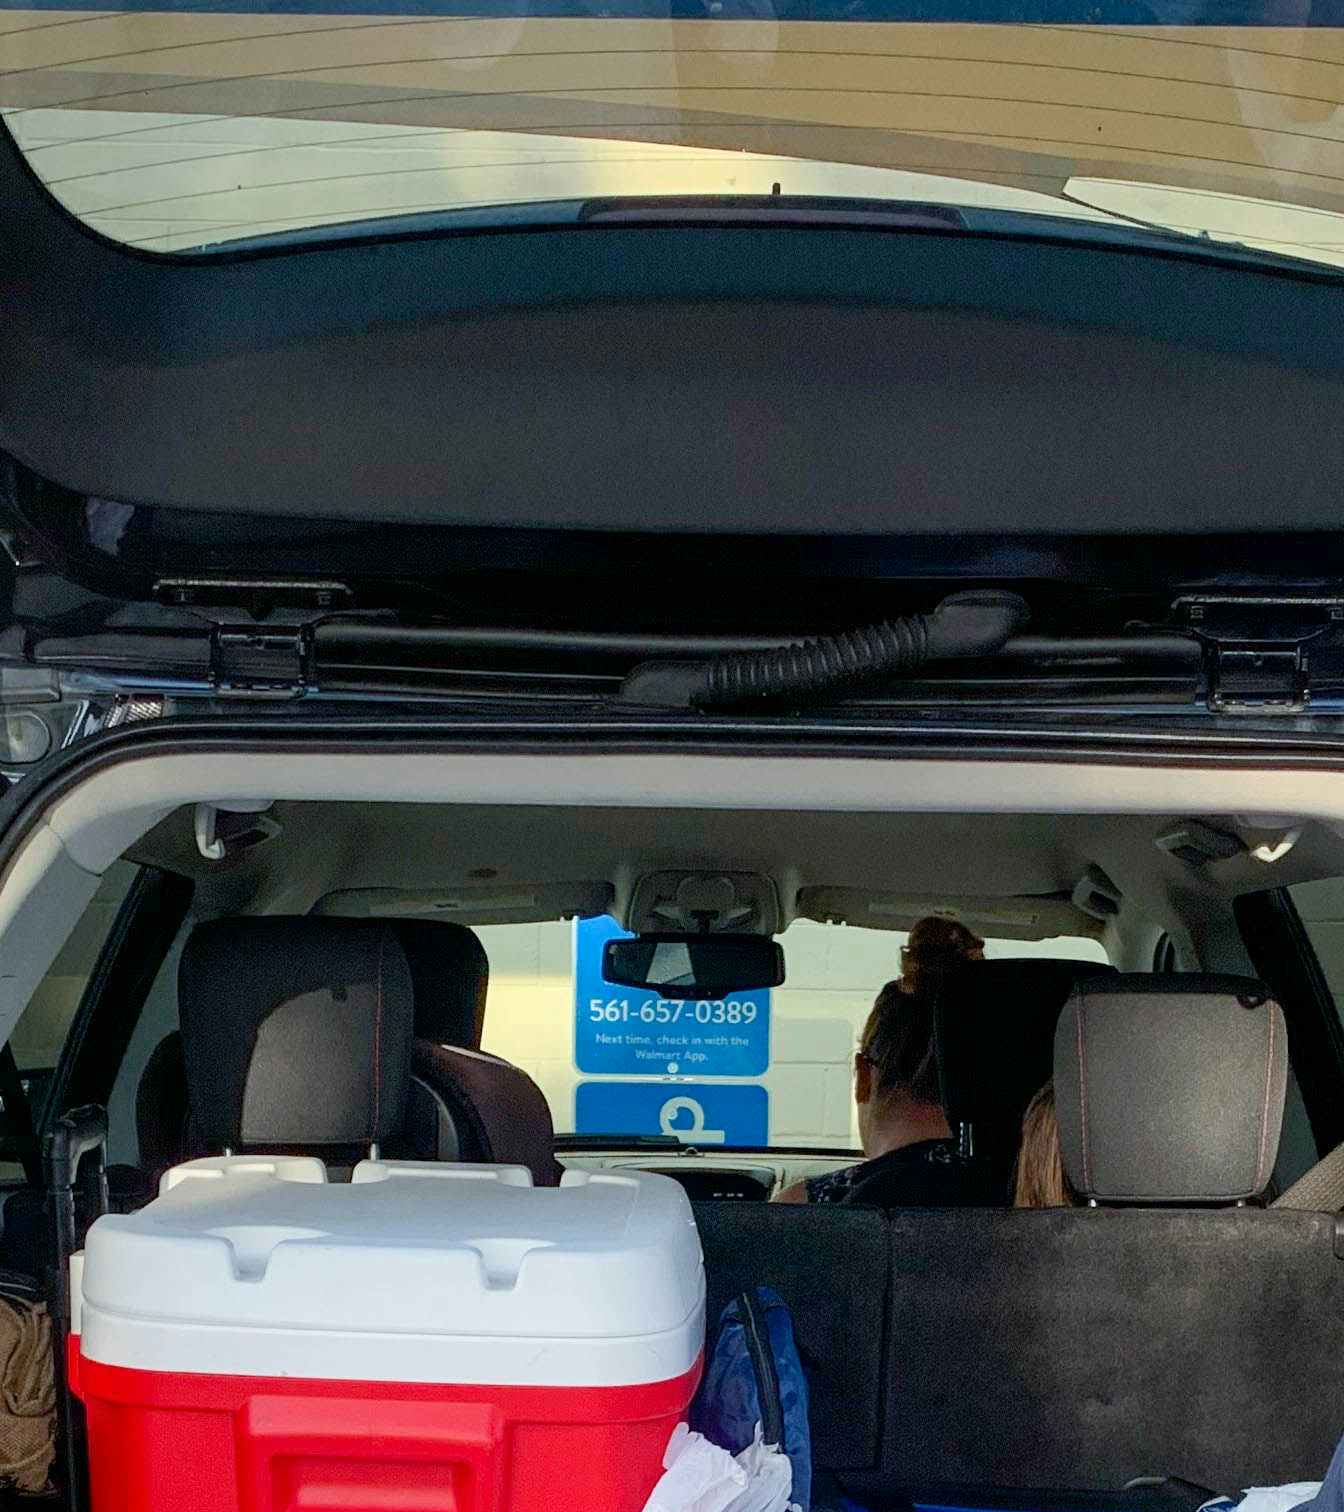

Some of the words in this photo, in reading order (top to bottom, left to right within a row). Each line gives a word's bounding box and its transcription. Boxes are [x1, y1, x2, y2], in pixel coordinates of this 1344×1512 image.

[589, 999, 757, 1024] 561-657-0389
[595, 1033, 623, 1044] Next
[656, 1033, 688, 1045] check
[691, 1034, 702, 1045] in
[704, 1034, 729, 1046] with
[730, 1035, 749, 1046] the
[635, 1049, 681, 1061] Walmart
[683, 1050, 709, 1063] App.
